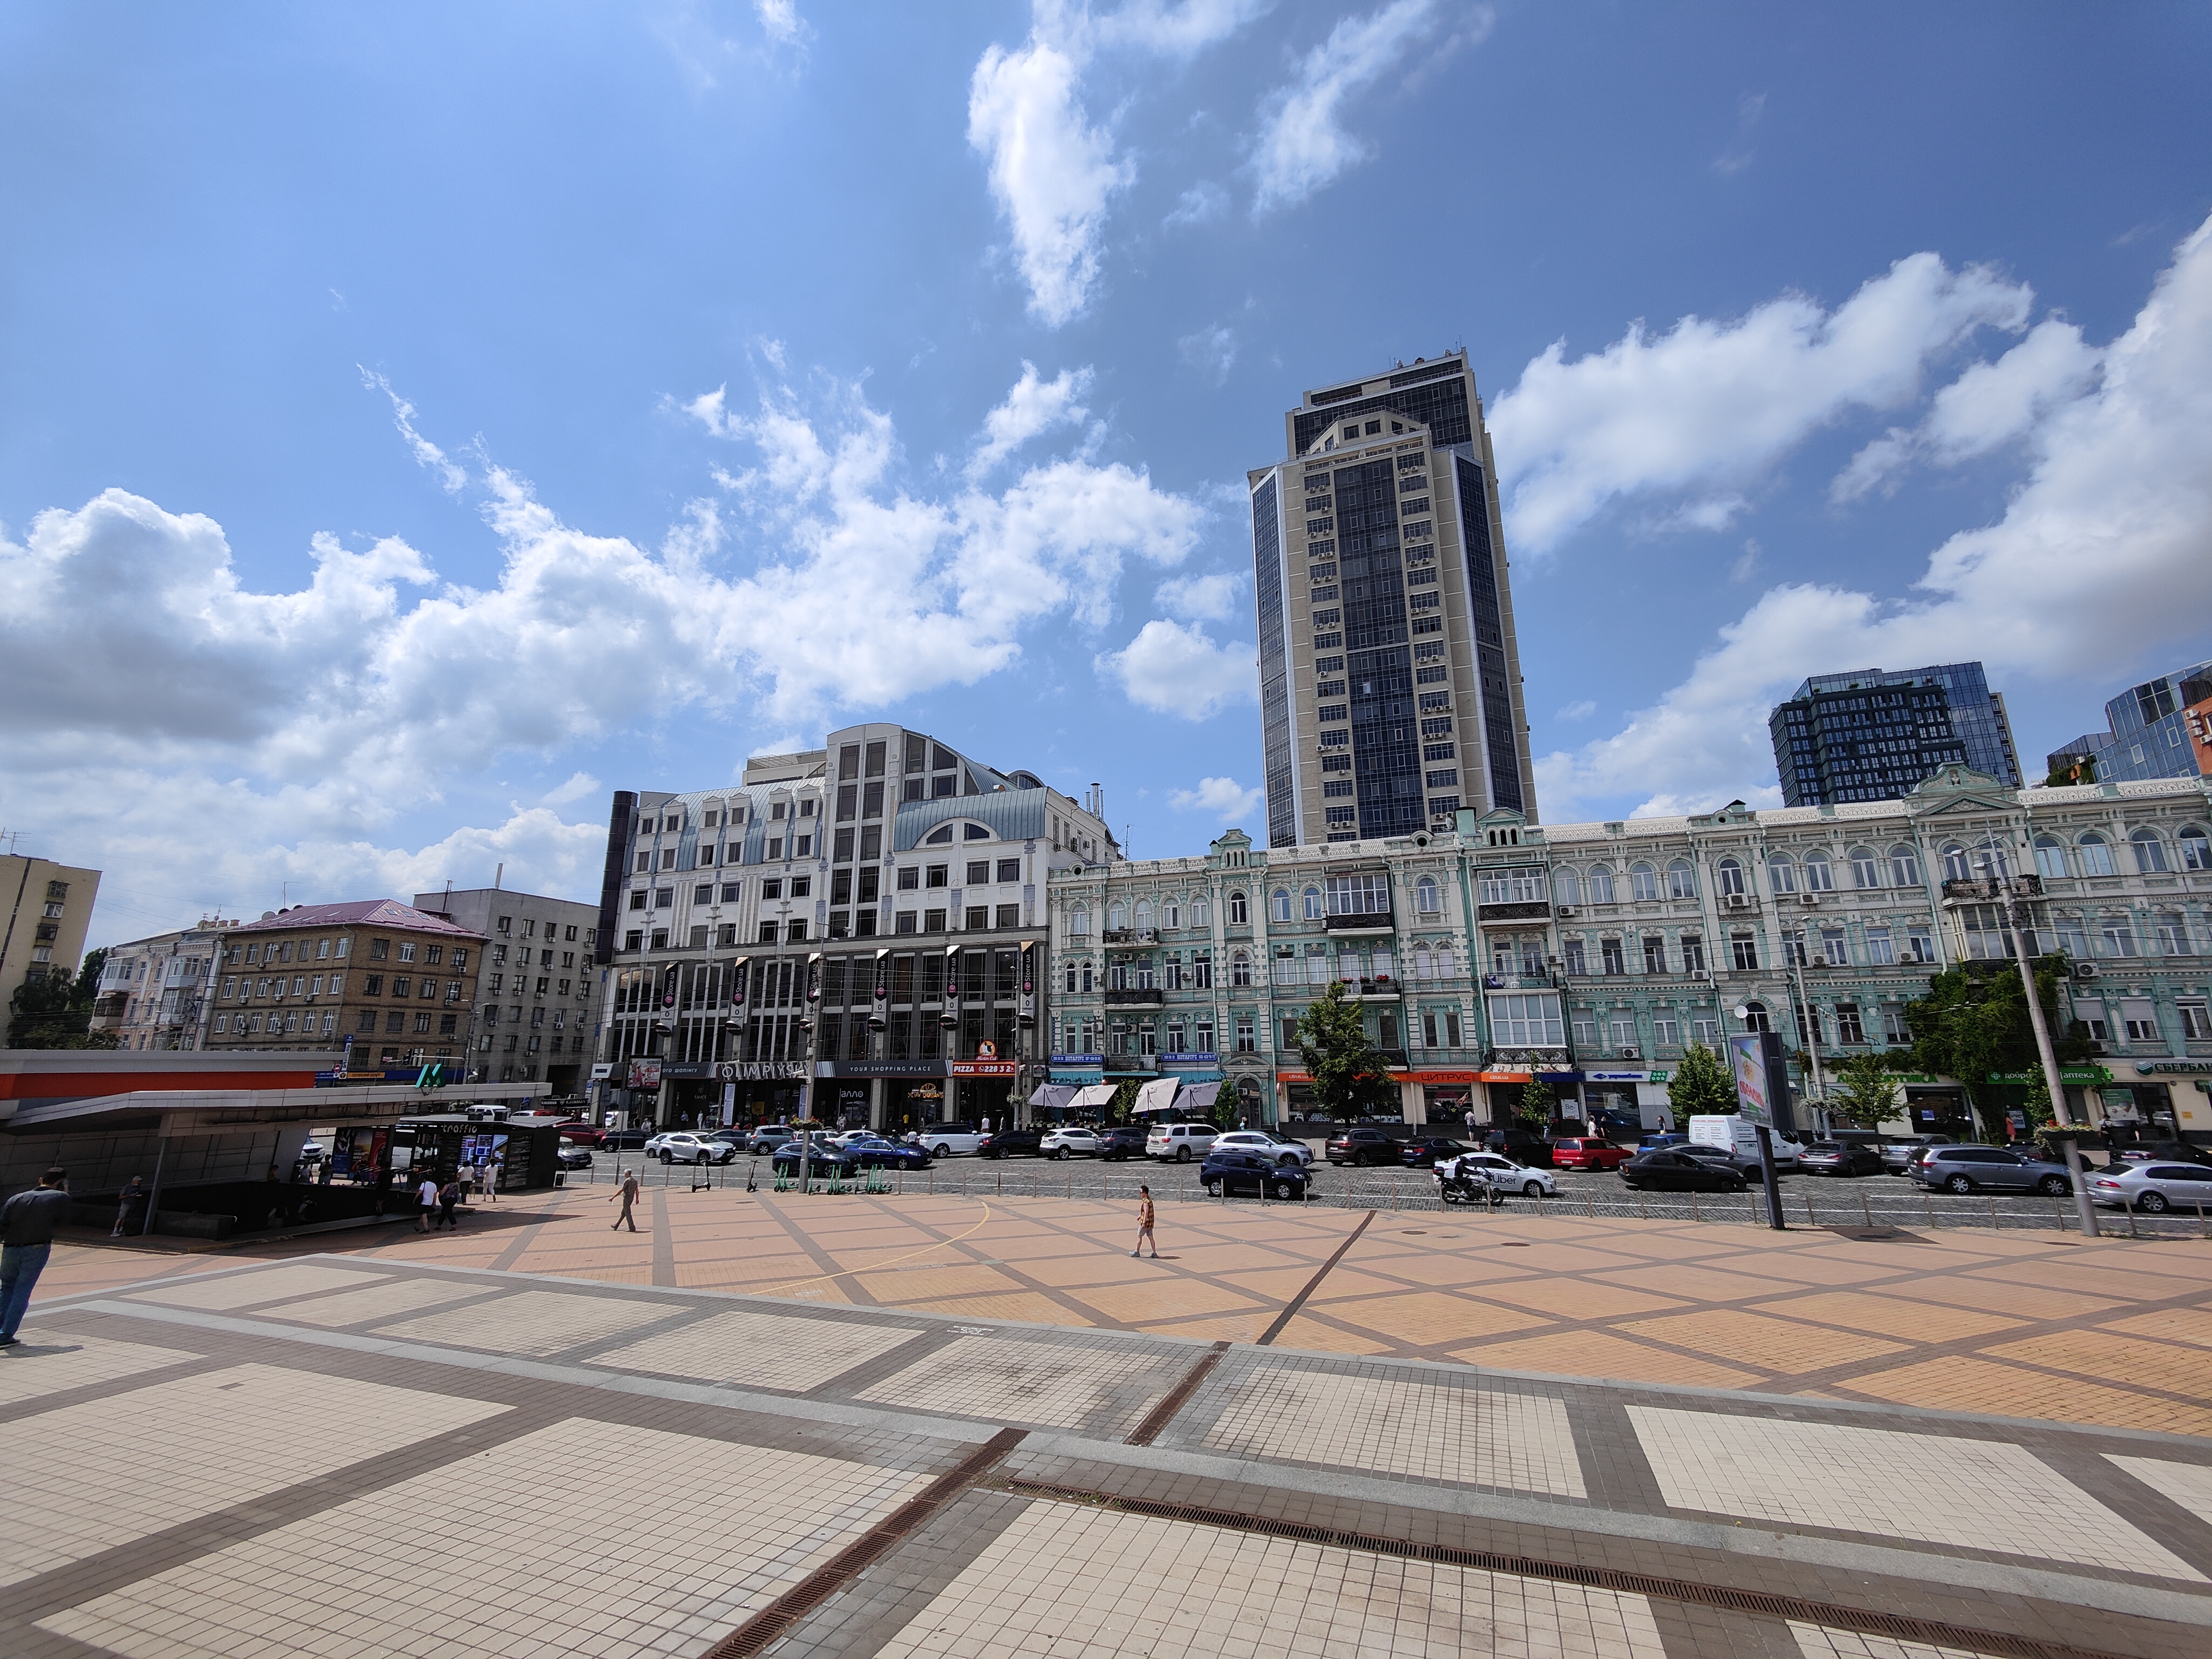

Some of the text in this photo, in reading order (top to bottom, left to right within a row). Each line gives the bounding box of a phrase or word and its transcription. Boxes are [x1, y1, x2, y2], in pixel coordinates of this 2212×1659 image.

[721, 1064, 811, 1078] OLIMPIYSKY
[1421, 1073, 1471, 1081] ЦИТРУС
[443, 1123, 477, 1133] traffic
[1492, 1174, 1517, 1184] Uber
